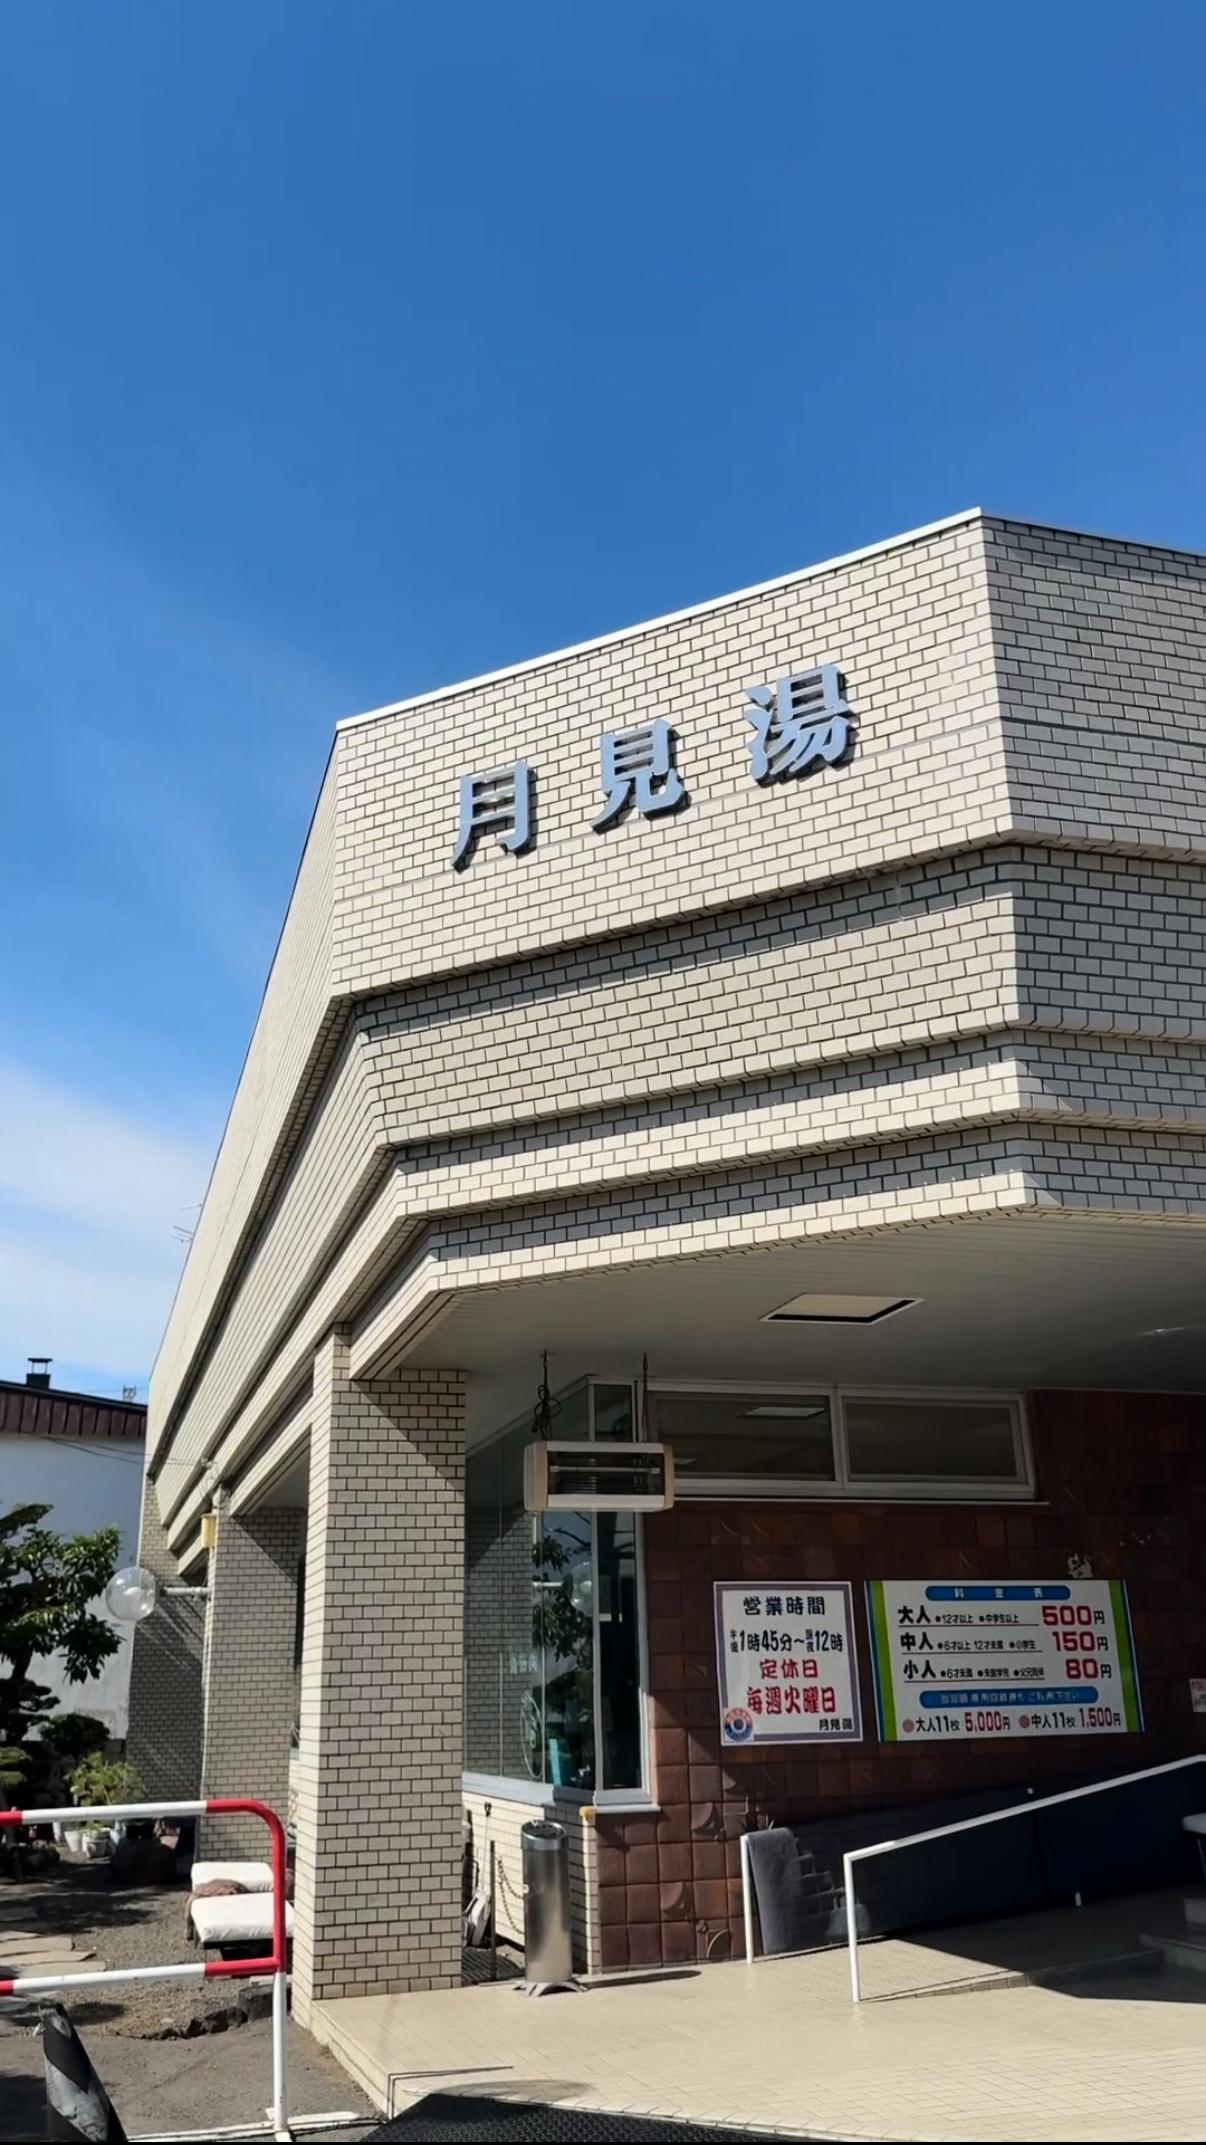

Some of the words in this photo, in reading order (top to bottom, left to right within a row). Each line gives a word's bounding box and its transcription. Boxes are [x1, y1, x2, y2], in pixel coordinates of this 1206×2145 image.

[452, 663, 854, 872] 月見湯
[954, 1586, 1043, 1599] 料金表
[743, 1596, 825, 1616] 営業時間
[898, 1605, 931, 1624] 大人
[942, 1614, 973, 1624] 12才以上
[985, 1613, 1019, 1624] 中学生以上
[1042, 1605, 1105, 1626] 500円
[900, 1632, 933, 1651] 中人
[944, 1640, 971, 1651] 6才以上
[974, 1640, 1004, 1650] 12才未満
[1015, 1640, 1036, 1650] 小学生
[1052, 1631, 1109, 1652] 150円
[760, 1658, 818, 1679] 定休日
[903, 1660, 937, 1679] 小人
[1065, 1658, 1112, 1680] 80円
[747, 1686, 837, 1715] 毎週火曜日
[819, 1718, 853, 1731] 月見湯
[916, 1715, 960, 1733] 大人11枚
[964, 1711, 1011, 1732] 5,000円
[1031, 1712, 1075, 1730] 中人11枚
[1079, 1707, 1121, 1727] 1,500円
